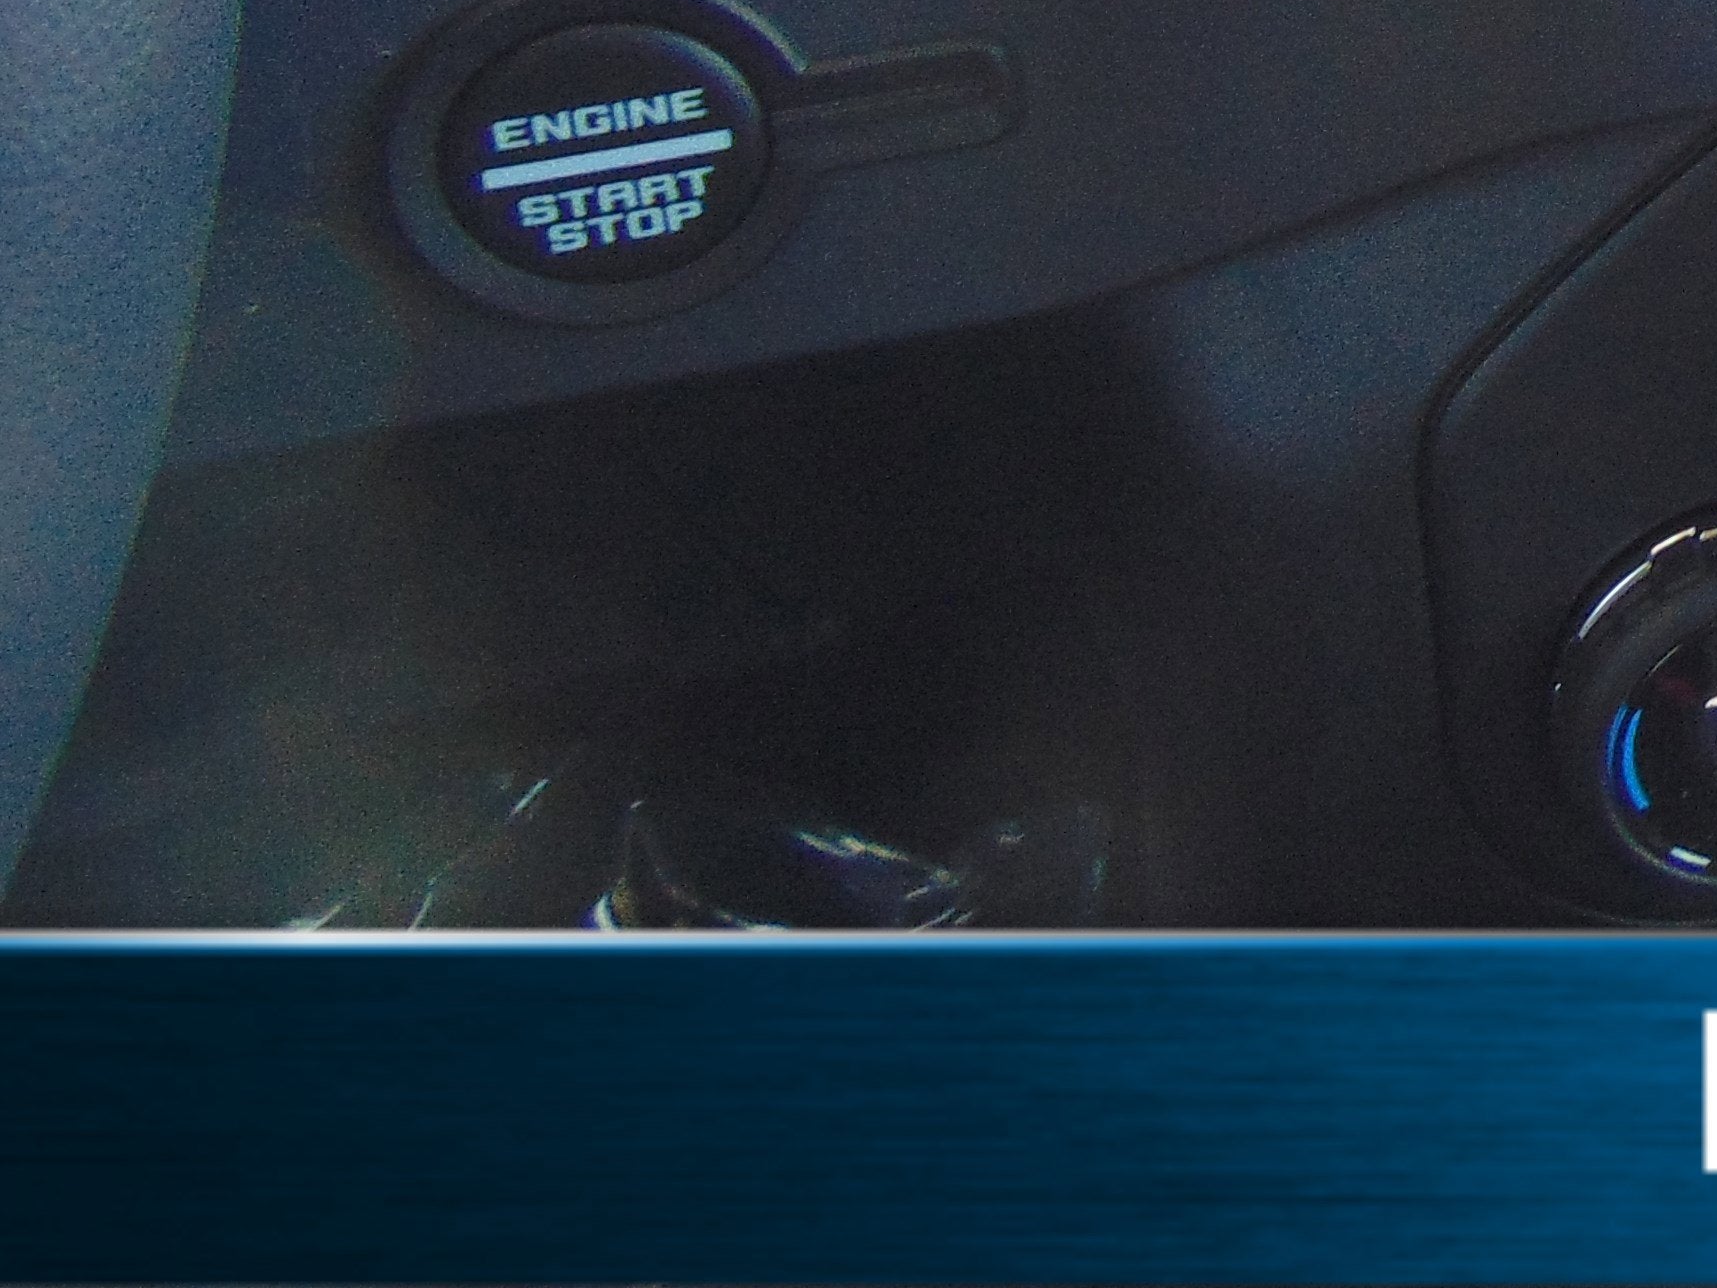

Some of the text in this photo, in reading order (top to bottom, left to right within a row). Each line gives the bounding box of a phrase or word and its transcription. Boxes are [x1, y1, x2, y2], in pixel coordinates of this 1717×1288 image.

[491, 87, 709, 152] ENGINE
[517, 164, 716, 228] START
[548, 201, 704, 256] STOP
